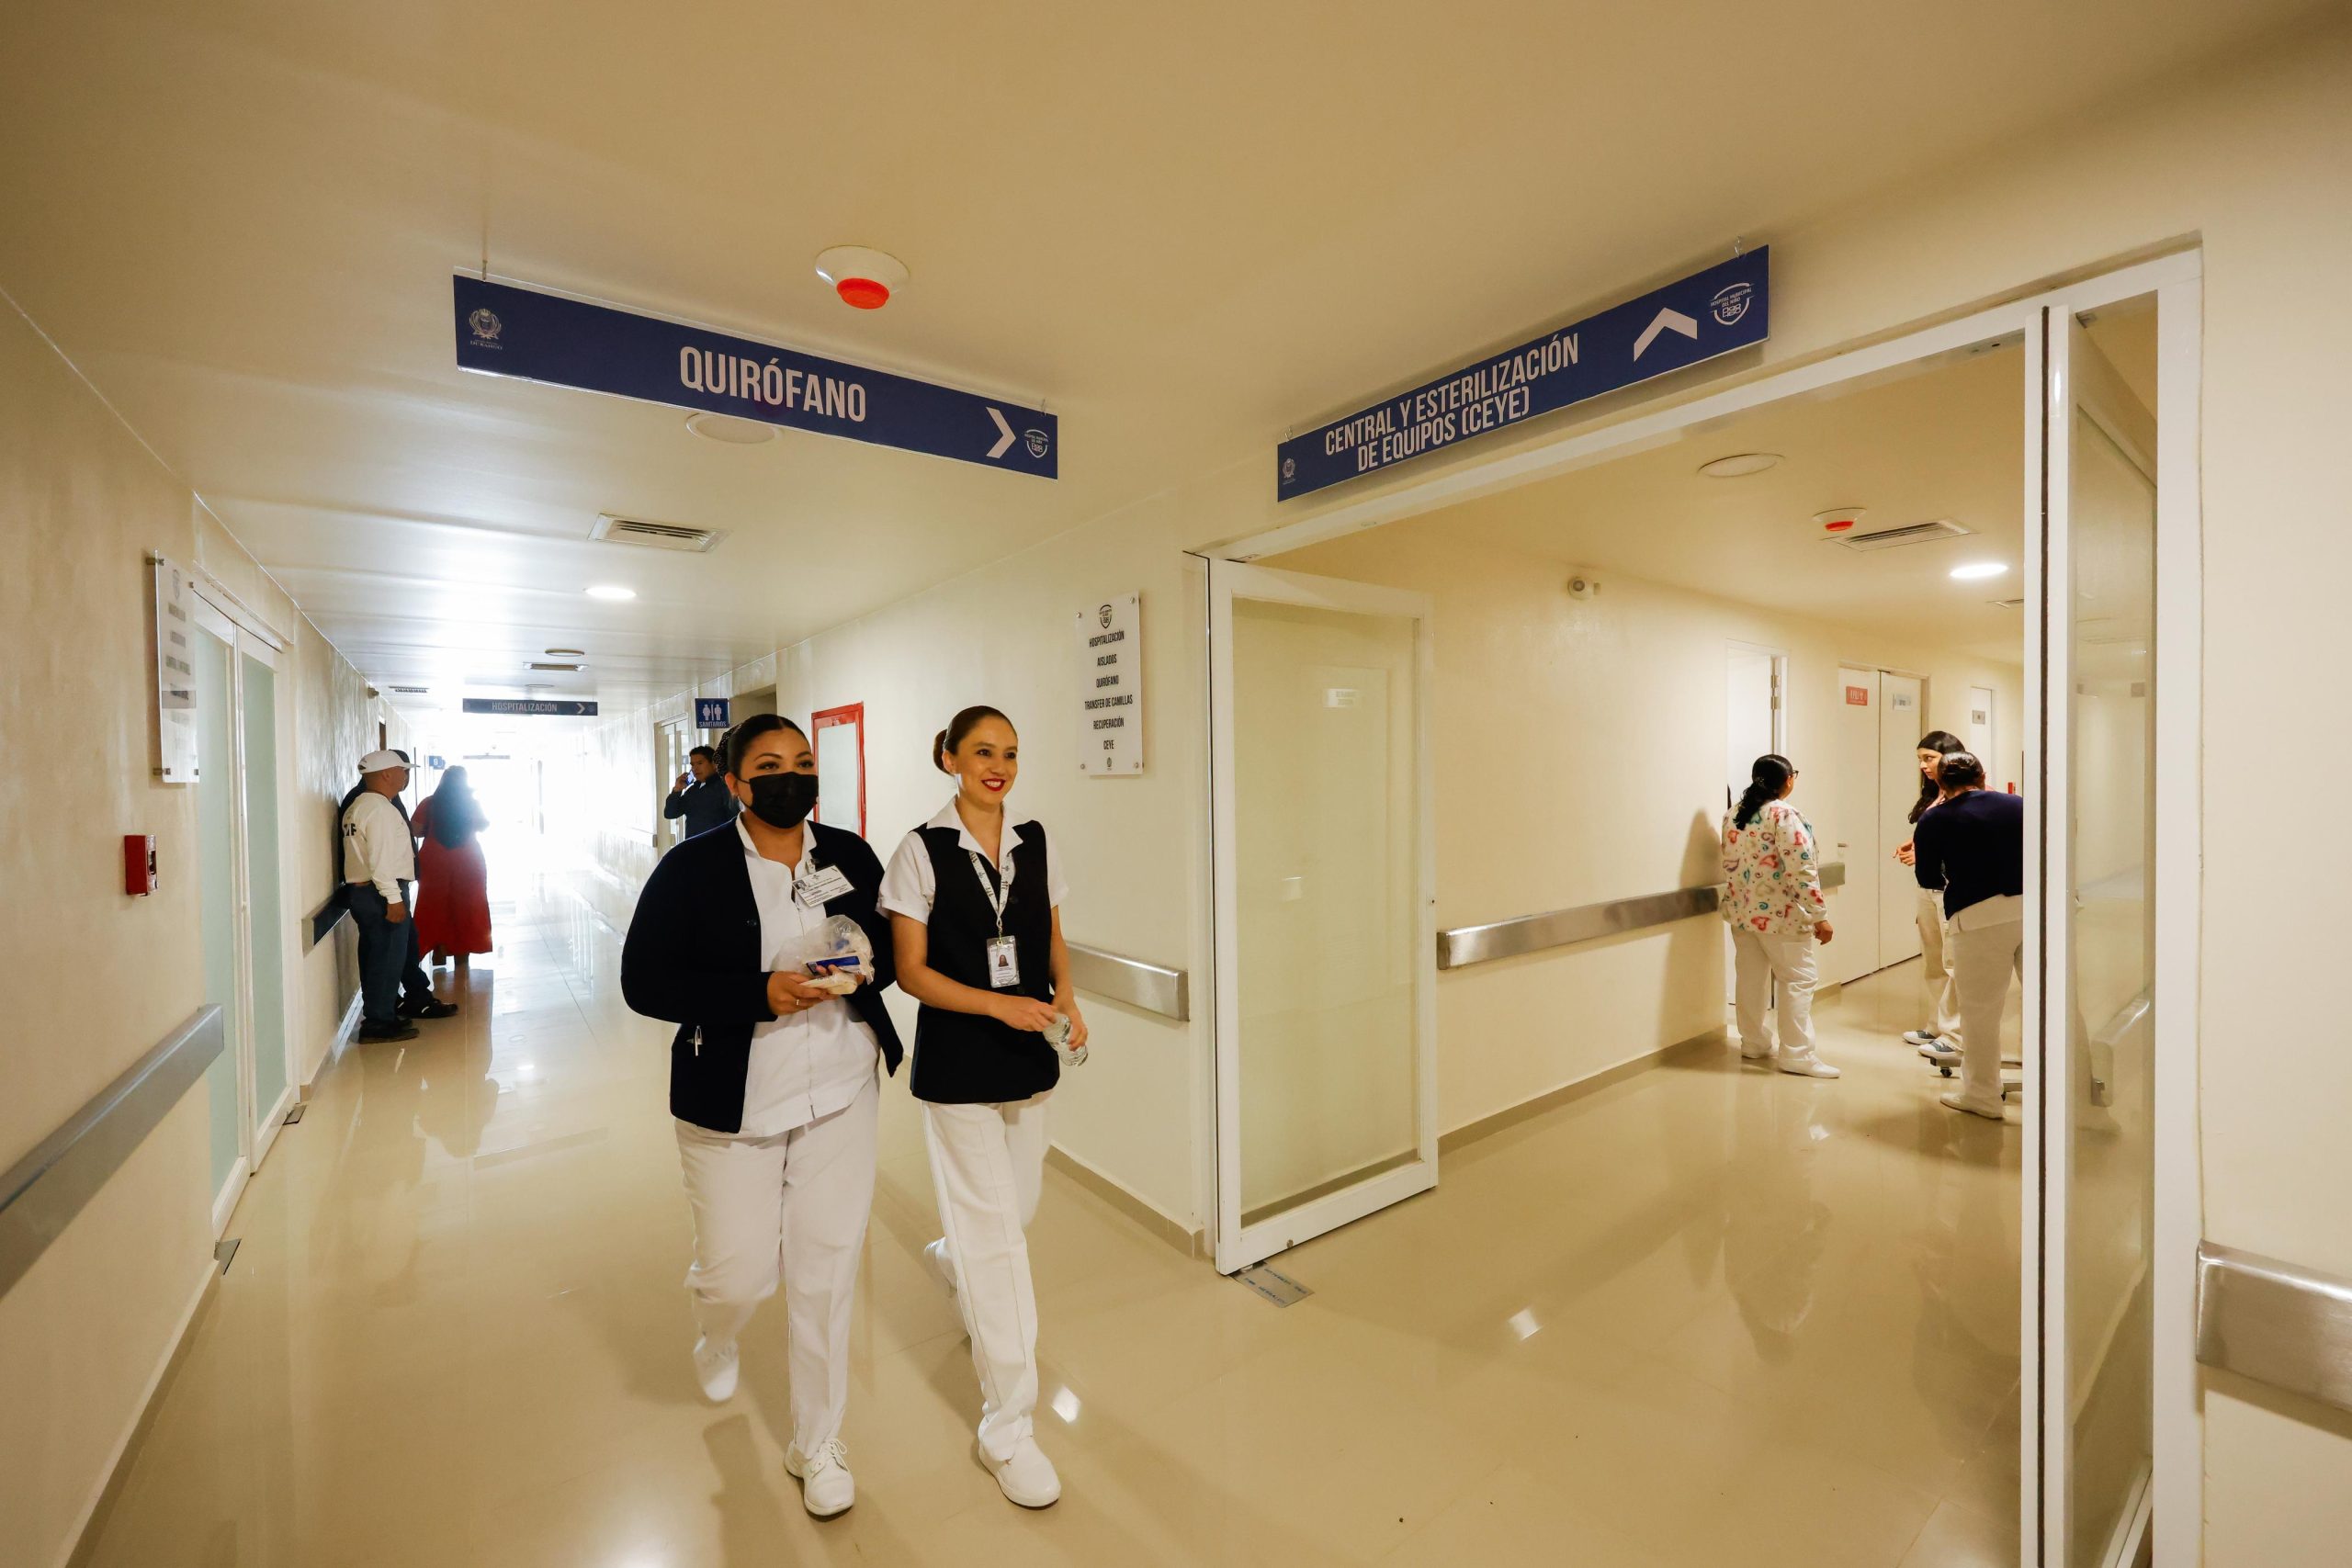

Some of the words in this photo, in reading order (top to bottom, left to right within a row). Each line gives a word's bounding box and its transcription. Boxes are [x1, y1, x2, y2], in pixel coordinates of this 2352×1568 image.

[680, 345, 866, 423] QUIRÓFANO
[1325, 407, 1396, 456] CENTRAL
[1399, 400, 1411, 427] Y
[1416, 333, 1579, 423] ESTERILIZACIÓN
[1357, 443, 1379, 472] DE
[1382, 412, 1456, 464] EQUIPOS
[1461, 386, 1530, 435] (CEYE)
[1089, 629, 1125, 648] HOSPITALIZACIÓN
[1097, 653, 1117, 667] AISLADOS
[1095, 674, 1119, 688] QUIRÓFANO
[492, 701, 558, 713] HOSPITALIZACIÓN
[1084, 698, 1105, 711] TRANSFER
[1105, 697, 1112, 708] DE
[1112, 694, 1133, 707] CAMILLAS
[1093, 716, 1125, 729] RECUPERACIÓN
[1103, 739, 1114, 750] CEYE
